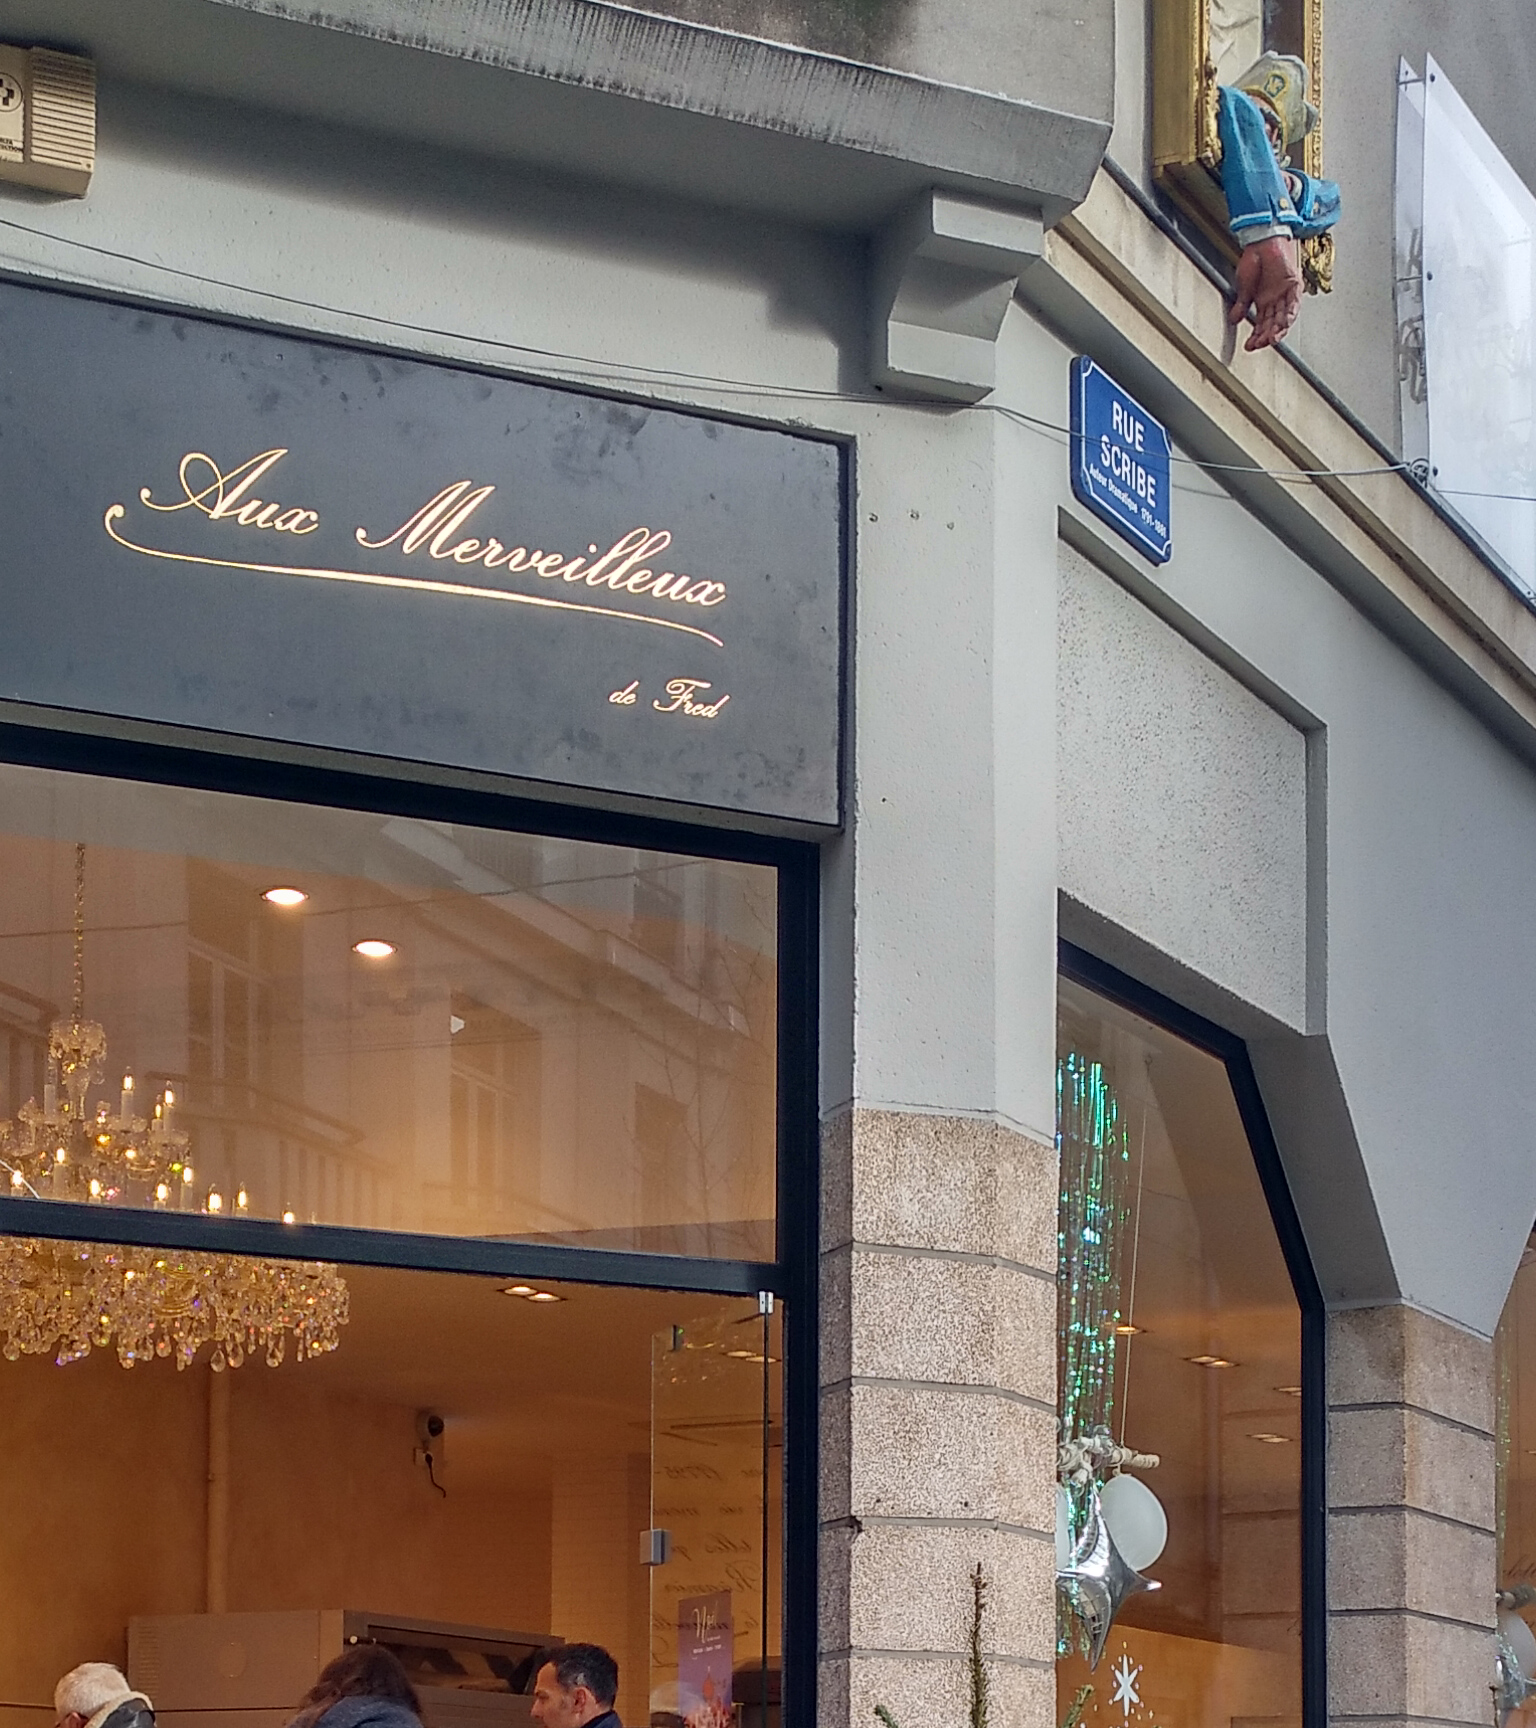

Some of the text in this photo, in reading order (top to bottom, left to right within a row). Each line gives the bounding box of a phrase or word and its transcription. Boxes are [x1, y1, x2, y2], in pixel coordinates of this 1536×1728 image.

[1112, 400, 1145, 452] RUE
[1100, 434, 1156, 508] SCRIBE
[139, 448, 727, 608] Aux Merveilleux
[608, 677, 731, 720] de Fred
